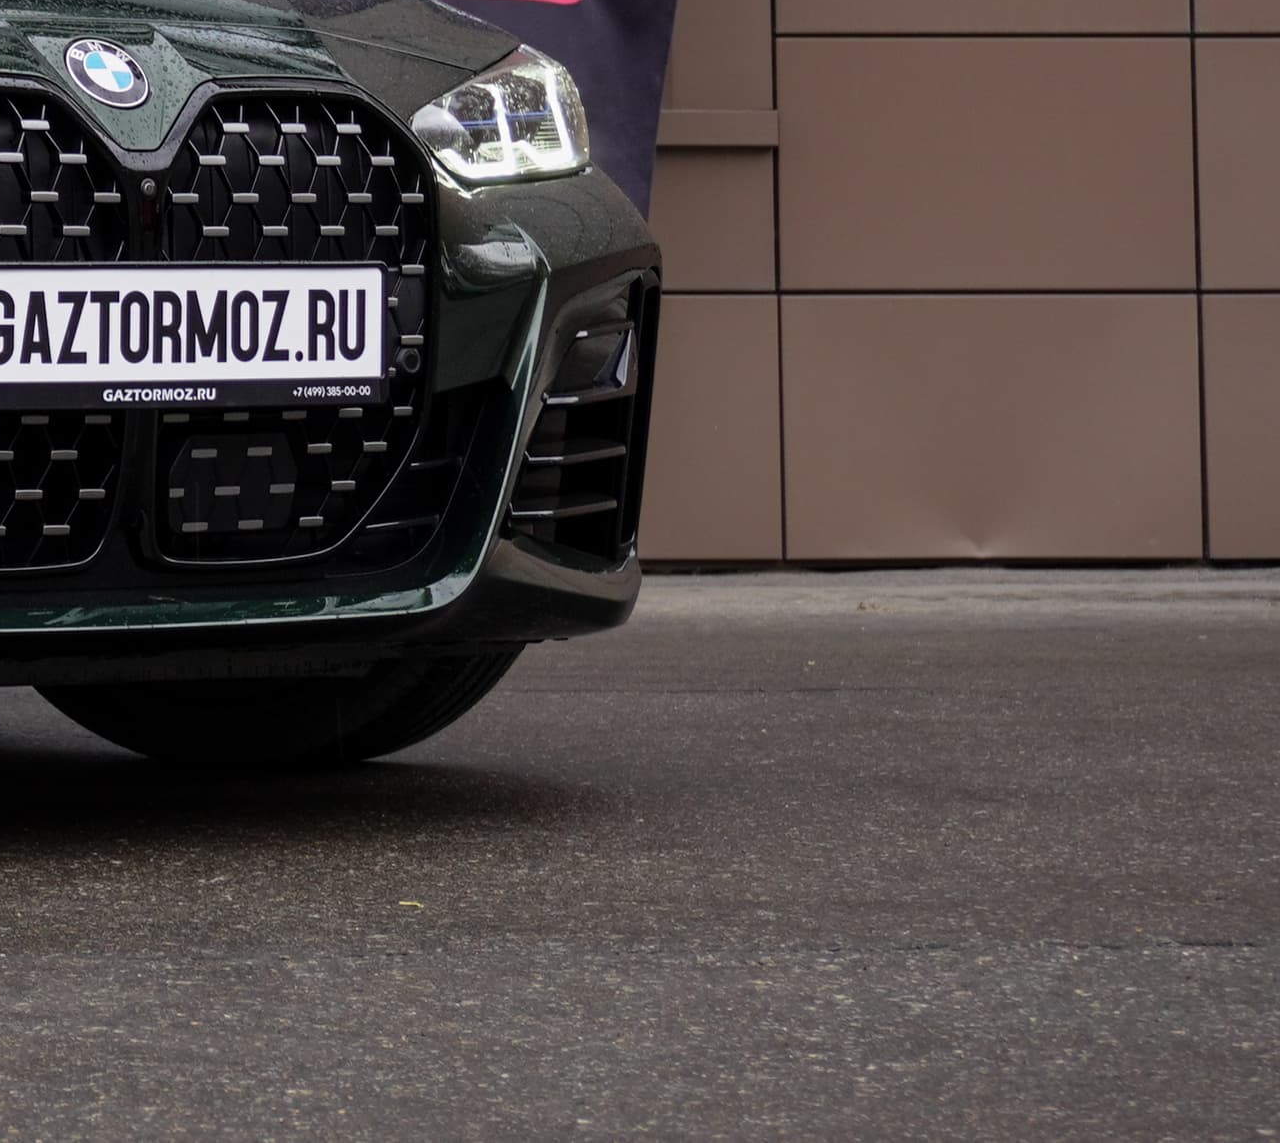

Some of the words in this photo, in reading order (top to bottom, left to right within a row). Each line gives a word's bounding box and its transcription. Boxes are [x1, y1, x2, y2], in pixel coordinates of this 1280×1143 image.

[102, 387, 217, 402] GAZTORMOZ.RU
[293, 386, 303, 397] +7
[303, 385, 326, 398] (499)
[326, 385, 371, 396] 385-00-00
